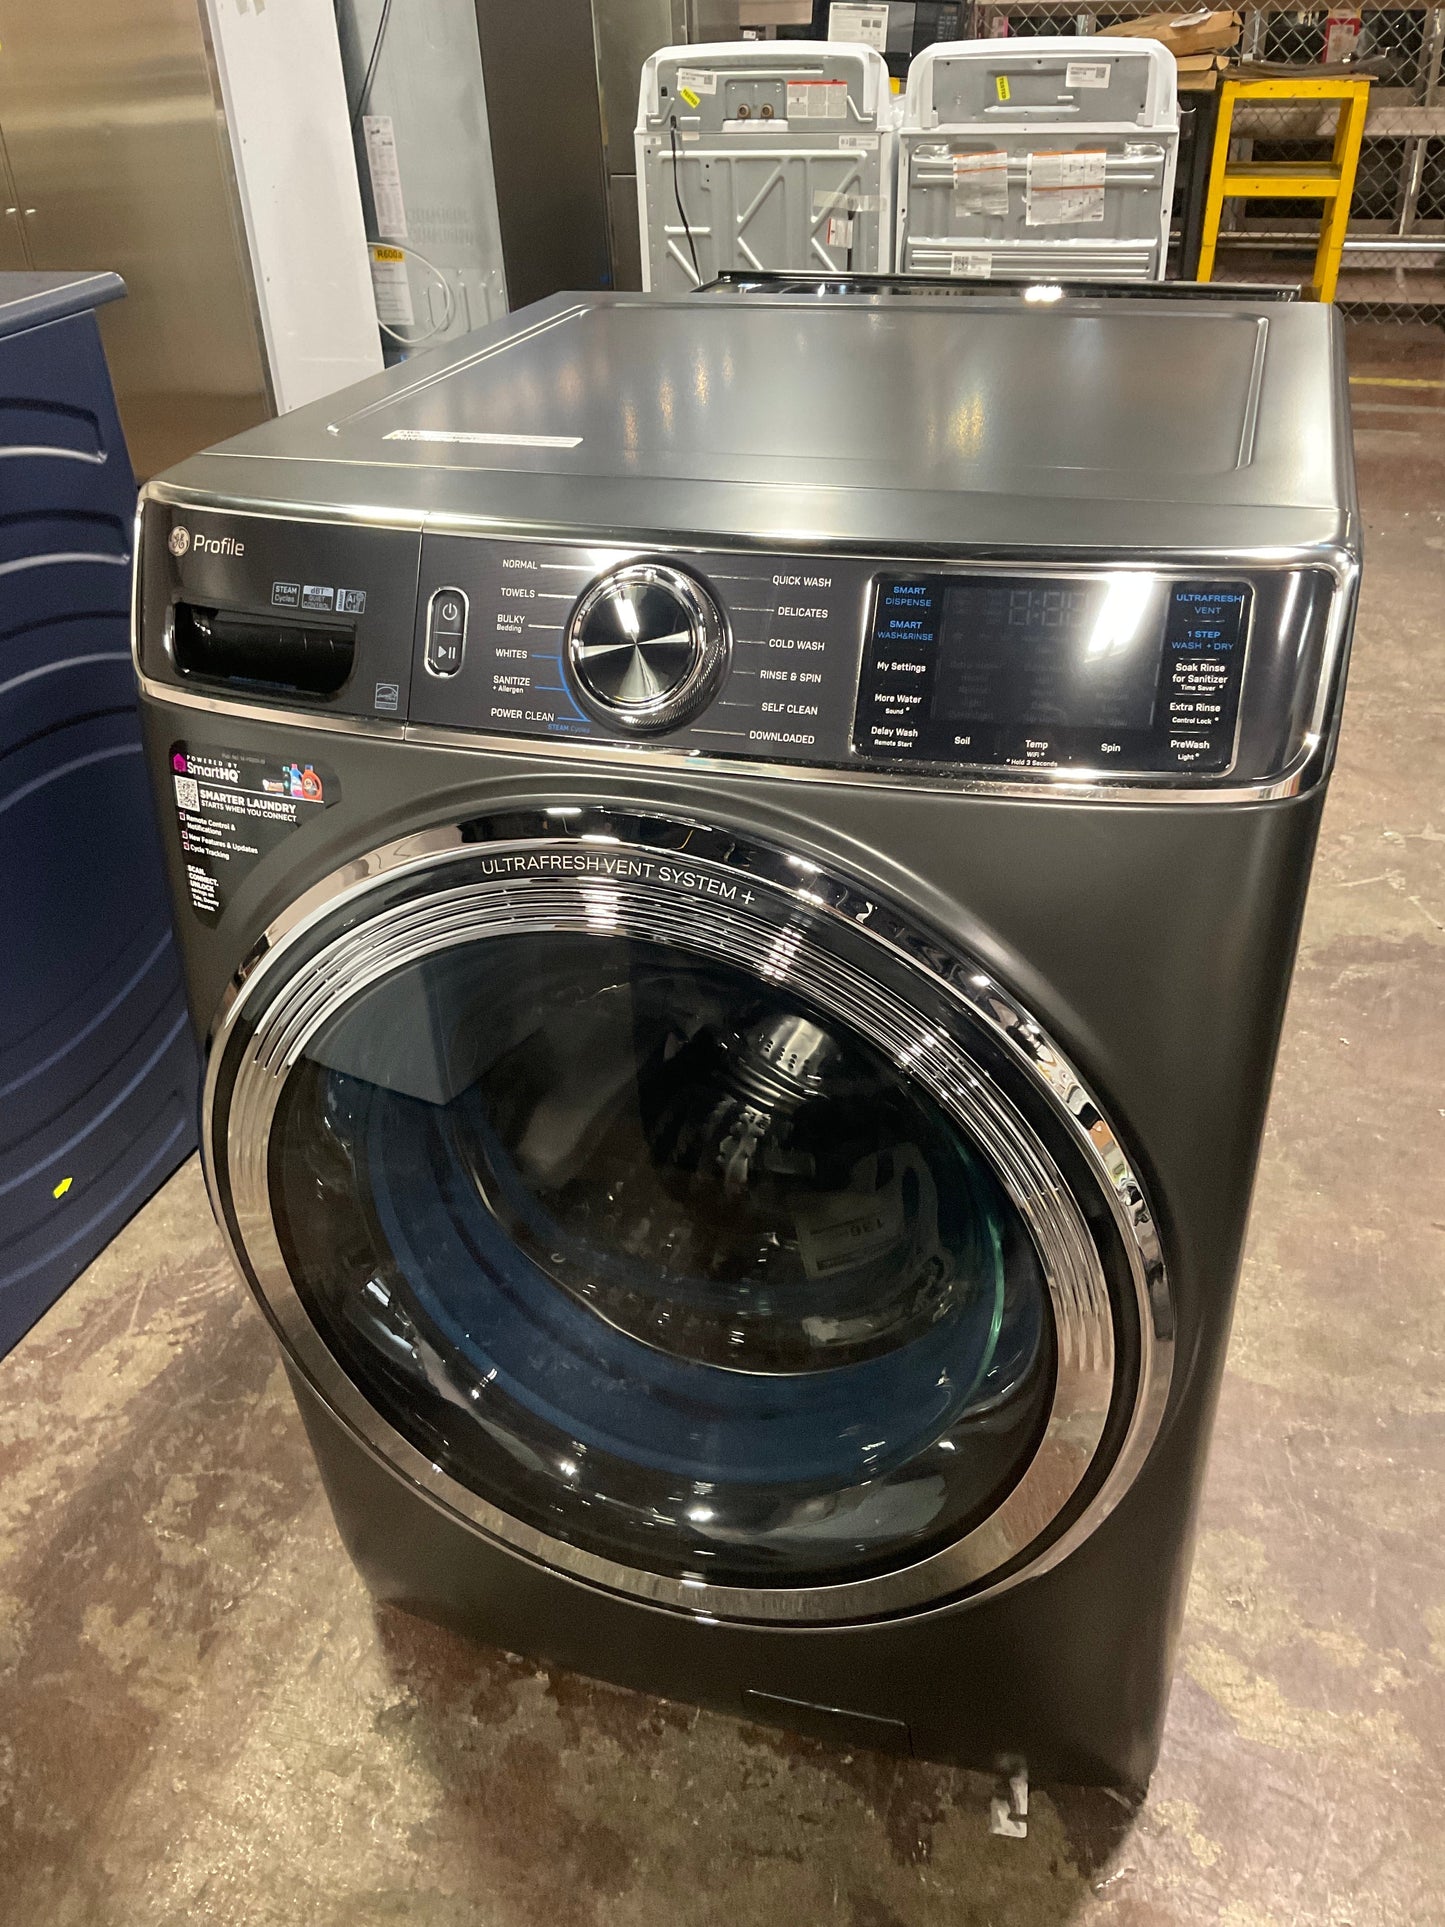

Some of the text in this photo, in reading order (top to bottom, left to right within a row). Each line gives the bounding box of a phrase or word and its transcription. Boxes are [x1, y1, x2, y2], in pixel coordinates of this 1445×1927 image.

[998, 77, 1007, 99] TESTED
[193, 534, 245, 557] Profile
[502, 559, 538, 570] NORMAL
[772, 575, 832, 588] QUICK WASH
[275, 585, 297, 595] STEAM
[501, 588, 536, 599] TOWELS
[893, 586, 926, 596] SMART
[275, 594, 295, 603] Cycles
[885, 597, 932, 608] DISPENSE
[1176, 593, 1242, 604] ULTRAFRESH
[777, 607, 829, 619] DELICATES
[1194, 606, 1221, 616] VENT
[497, 614, 525, 625] BULKY
[889, 620, 922, 630] SMART
[496, 623, 522, 633] Bedding
[877, 631, 934, 641] WASH&RINSE
[1195, 630, 1221, 639] STEP
[769, 639, 825, 651] COLD WASH
[1171, 641, 1202, 651] WASH
[1214, 642, 1234, 652] DRY
[495, 649, 528, 660] WHITES
[877, 662, 926, 674] My Settings
[1175, 663, 1226, 673] Soak Rinse
[493, 675, 531, 687] SANITIZE
[760, 670, 822, 684] RINSE & SPIN
[1172, 674, 1228, 684] for Sanitizer
[498, 684, 524, 694] Allergen
[874, 694, 922, 705] More Water
[761, 703, 818, 716] SELF CLEAN
[885, 708, 904, 716] Sound
[1169, 702, 1221, 713] Extra Rinse
[490, 708, 554, 722] POWER CLEAN
[1172, 716, 1212, 725] Control Lock
[547, 723, 590, 734] STEAM Cycles
[871, 728, 918, 739] Delay Wash
[749, 731, 815, 745] DOWNLOADED
[874, 739, 913, 748] Remote Start
[954, 735, 971, 746] Soil
[1025, 739, 1049, 751] Temp
[1101, 743, 1121, 754] Spin
[1170, 739, 1210, 750] PreWash
[186, 754, 223, 766] POWERED
[1178, 753, 1194, 762] Light
[1011, 759, 1058, 768] Hold 3 Seconds
[187, 762, 239, 783] SmartHQ
[200, 790, 297, 814] SMARTER LAUNDRY
[201, 800, 297, 822] STARTS WHEN YOU CONNECT
[186, 814, 208, 826] Remote
[208, 819, 230, 830] Control
[189, 833, 201, 842] New
[202, 836, 226, 848] Features
[232, 843, 258, 854] Updates
[190, 844, 230, 860] Cycle Tracking
[482, 855, 756, 905] ULTRAFRESH VENT SYSTEM +
